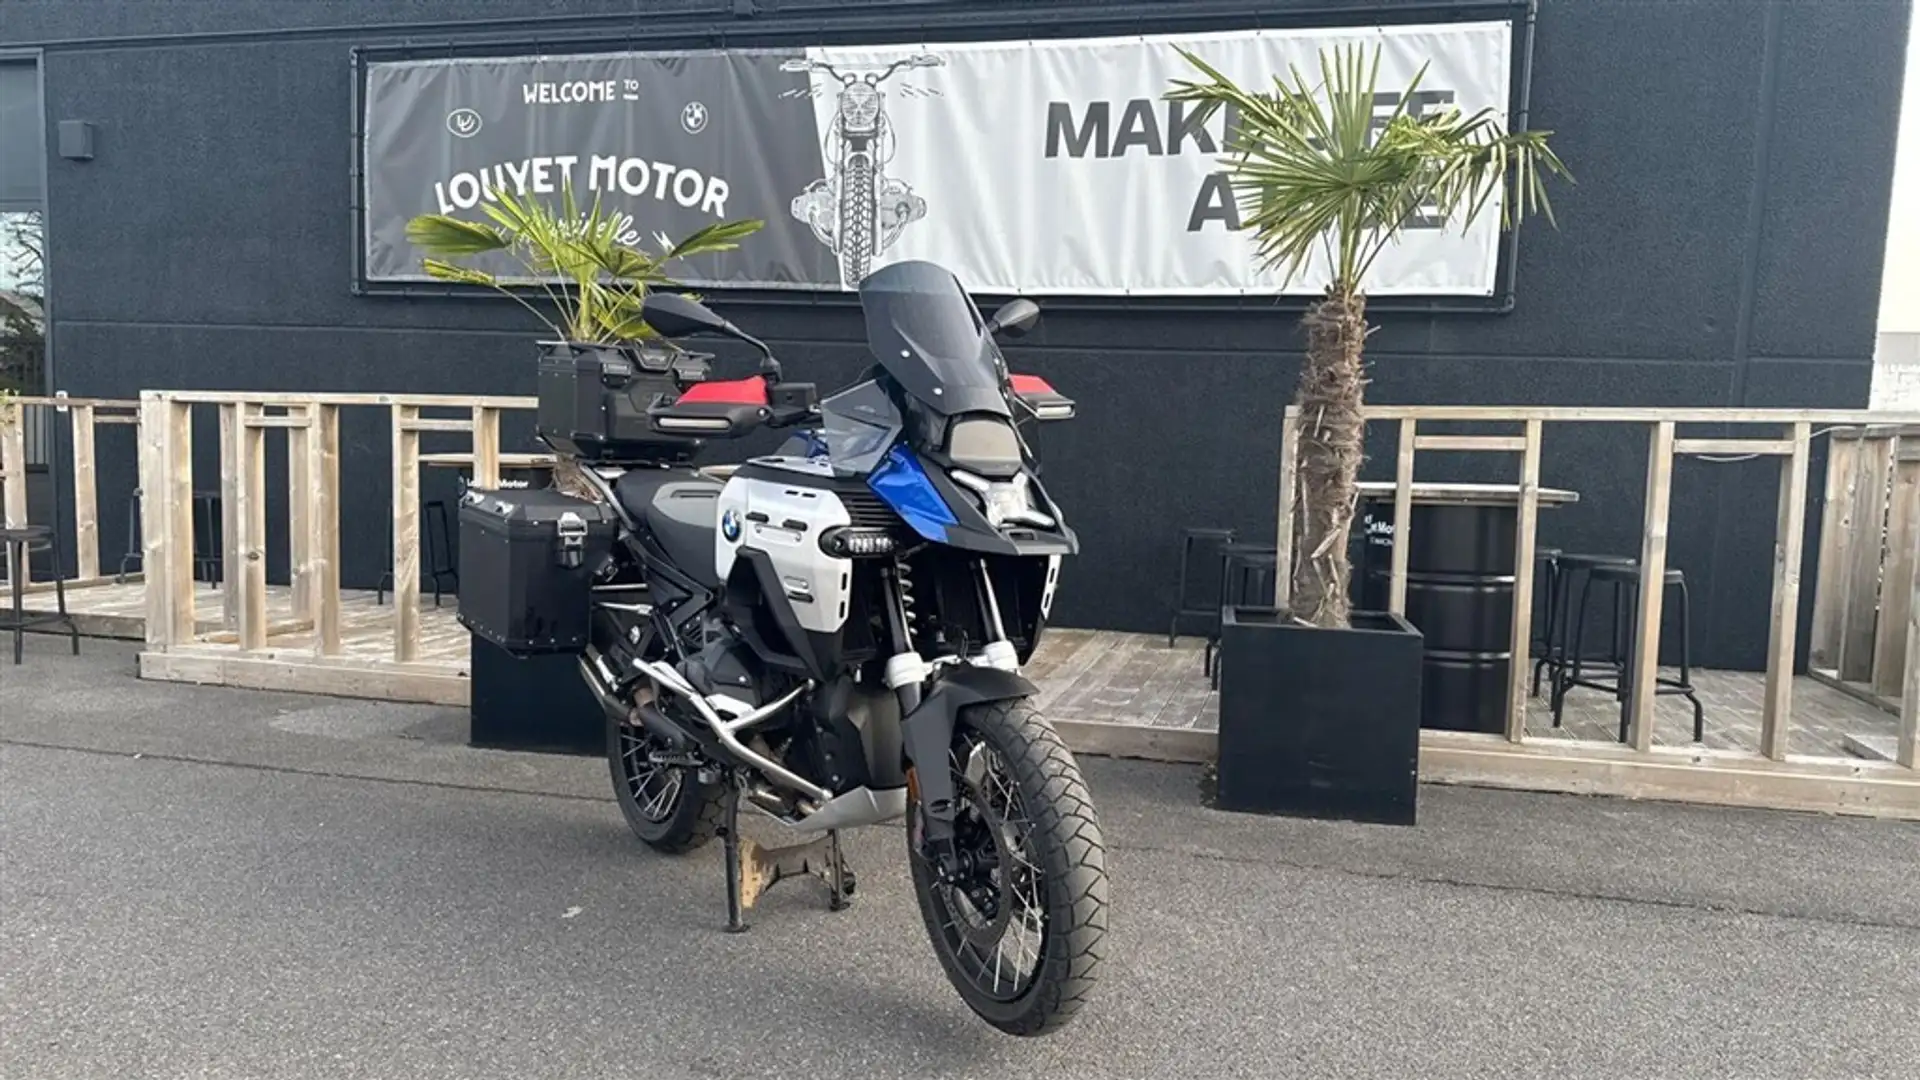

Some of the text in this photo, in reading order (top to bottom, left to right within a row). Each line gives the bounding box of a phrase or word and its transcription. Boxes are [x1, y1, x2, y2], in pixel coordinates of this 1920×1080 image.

[523, 79, 639, 104] WELCOME TO
[435, 154, 729, 219] LOUYET MOTOR
